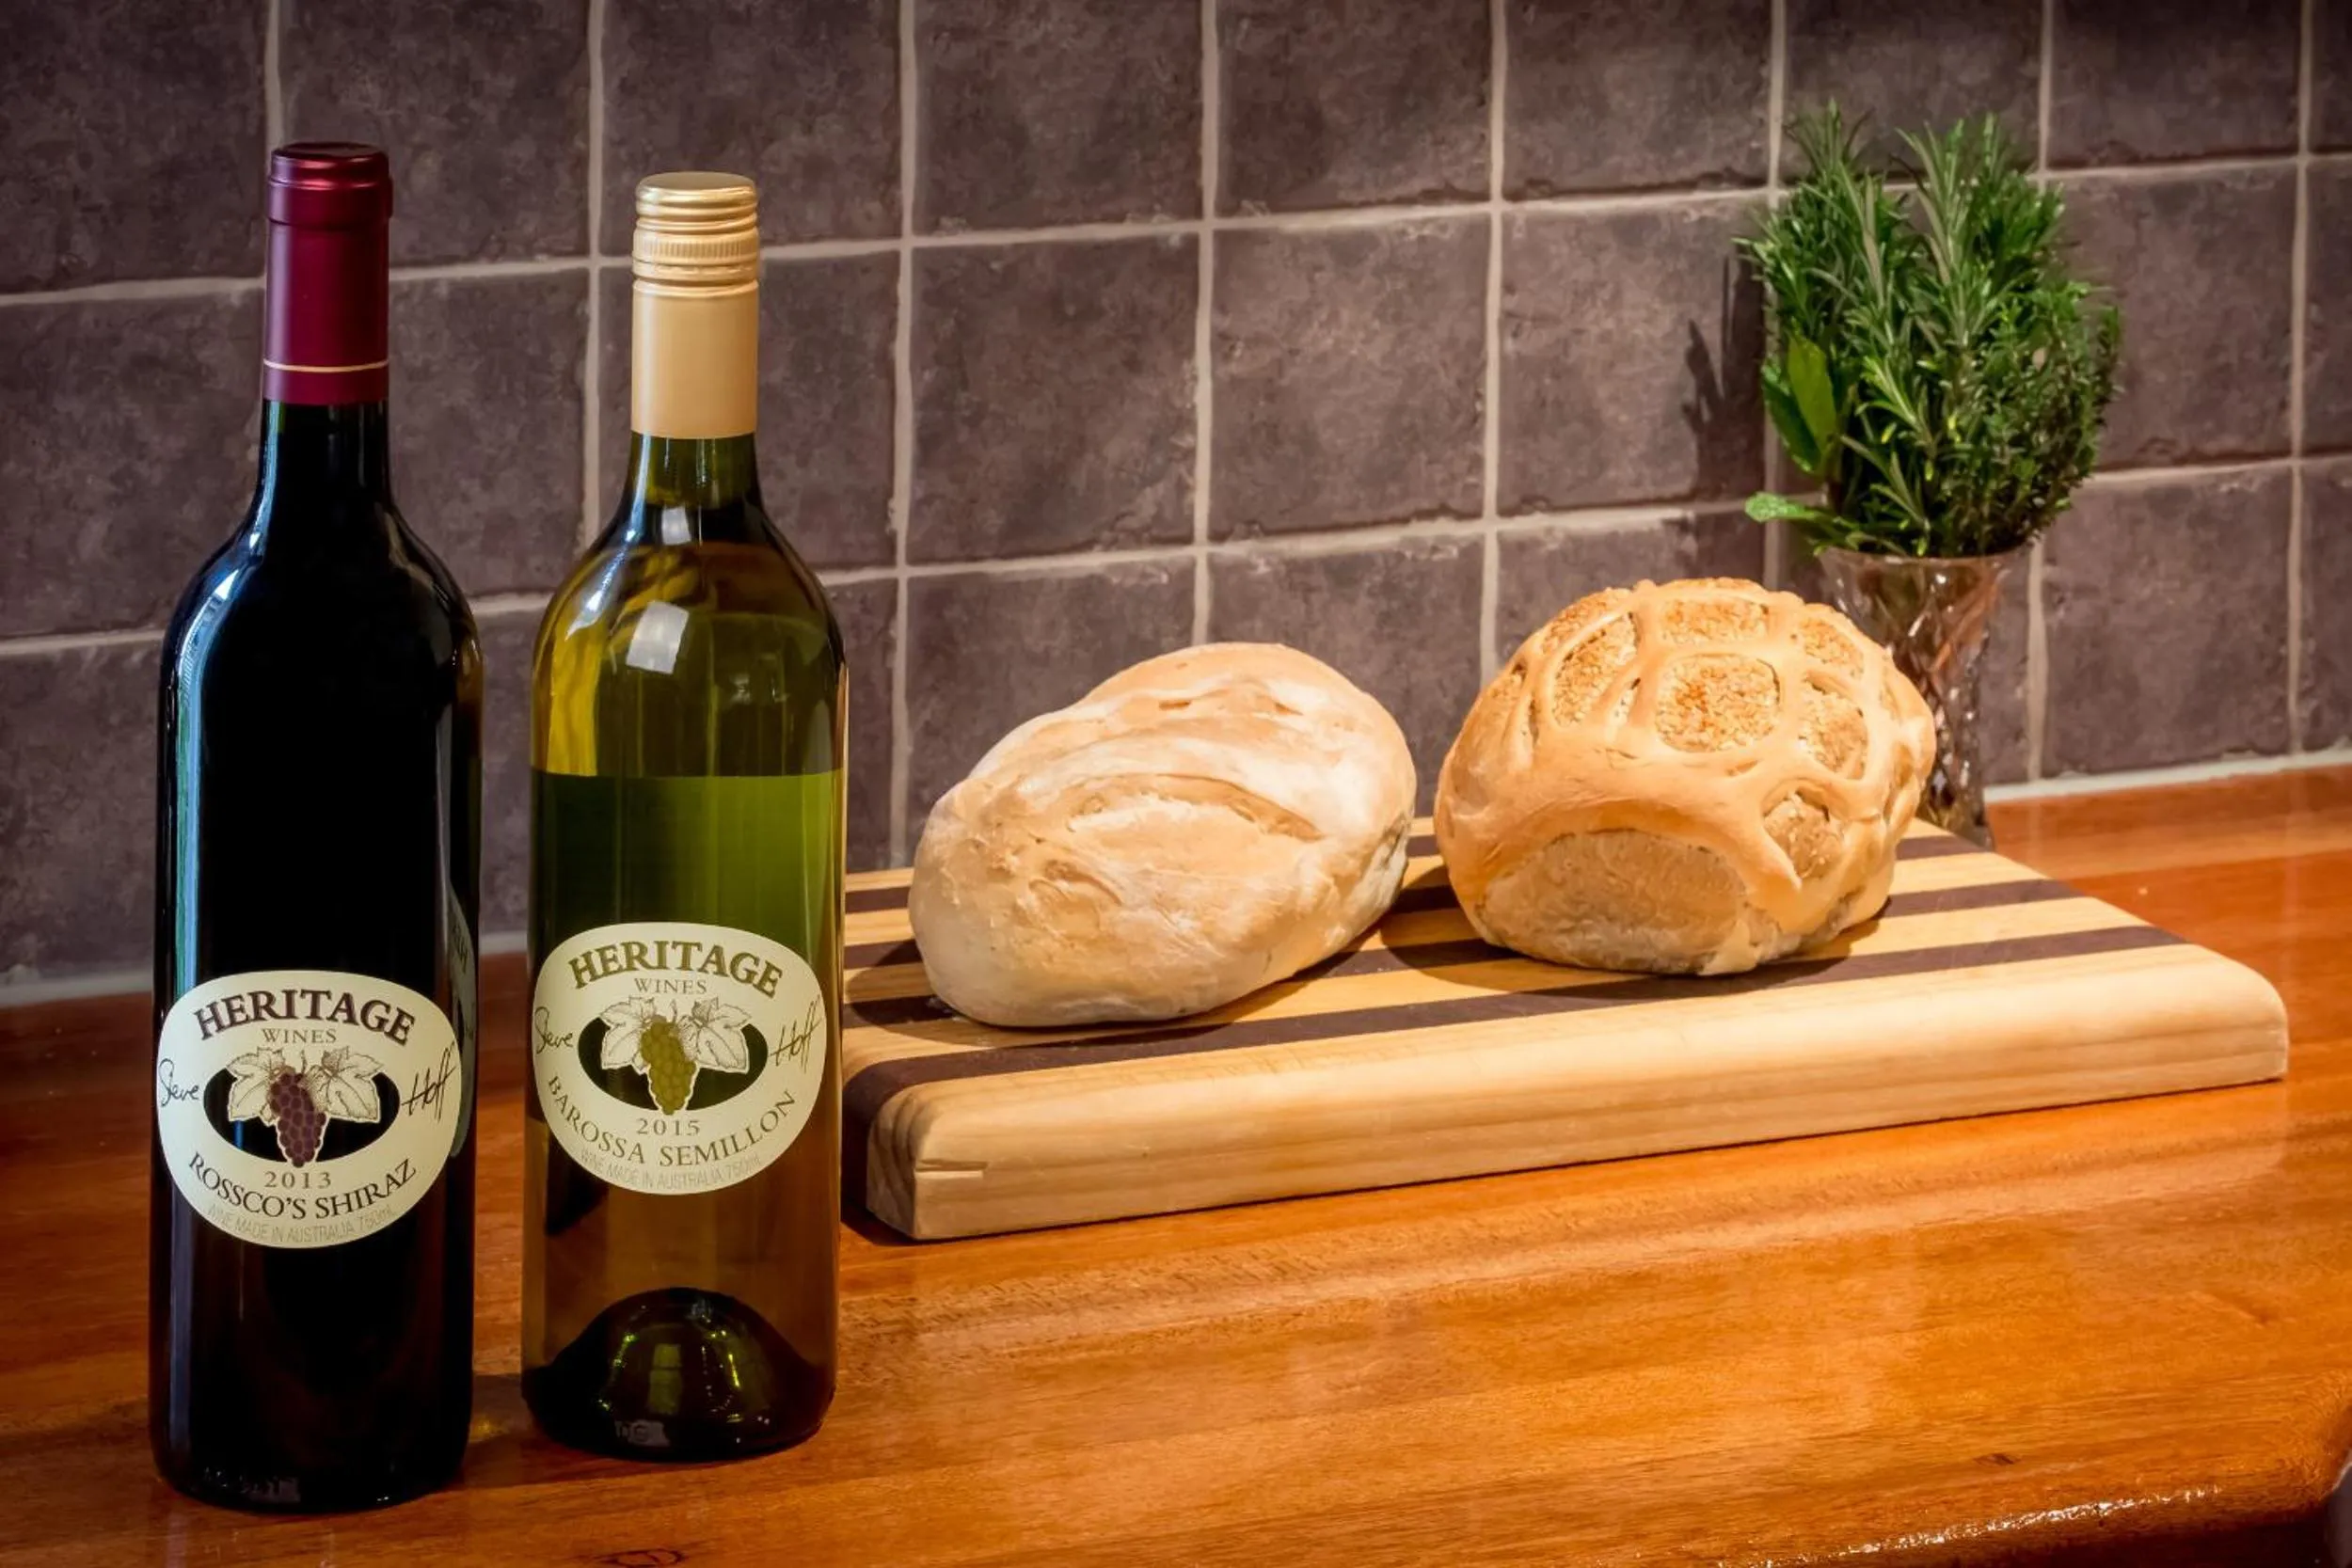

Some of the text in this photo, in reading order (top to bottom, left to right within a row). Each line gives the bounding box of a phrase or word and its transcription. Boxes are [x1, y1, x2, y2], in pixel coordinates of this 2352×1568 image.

[568, 940, 783, 999] HERITAGE
[633, 976, 707, 995] WINES
[193, 989, 416, 1047] HERITAGE
[261, 1027, 337, 1045] WINES
[548, 1075, 797, 1167] BAROSSA SEMILLON
[636, 1118, 701, 1136] 2015
[188, 1151, 417, 1220] ROSSCO'S SHIRAZ
[264, 1171, 332, 1189] 2013
